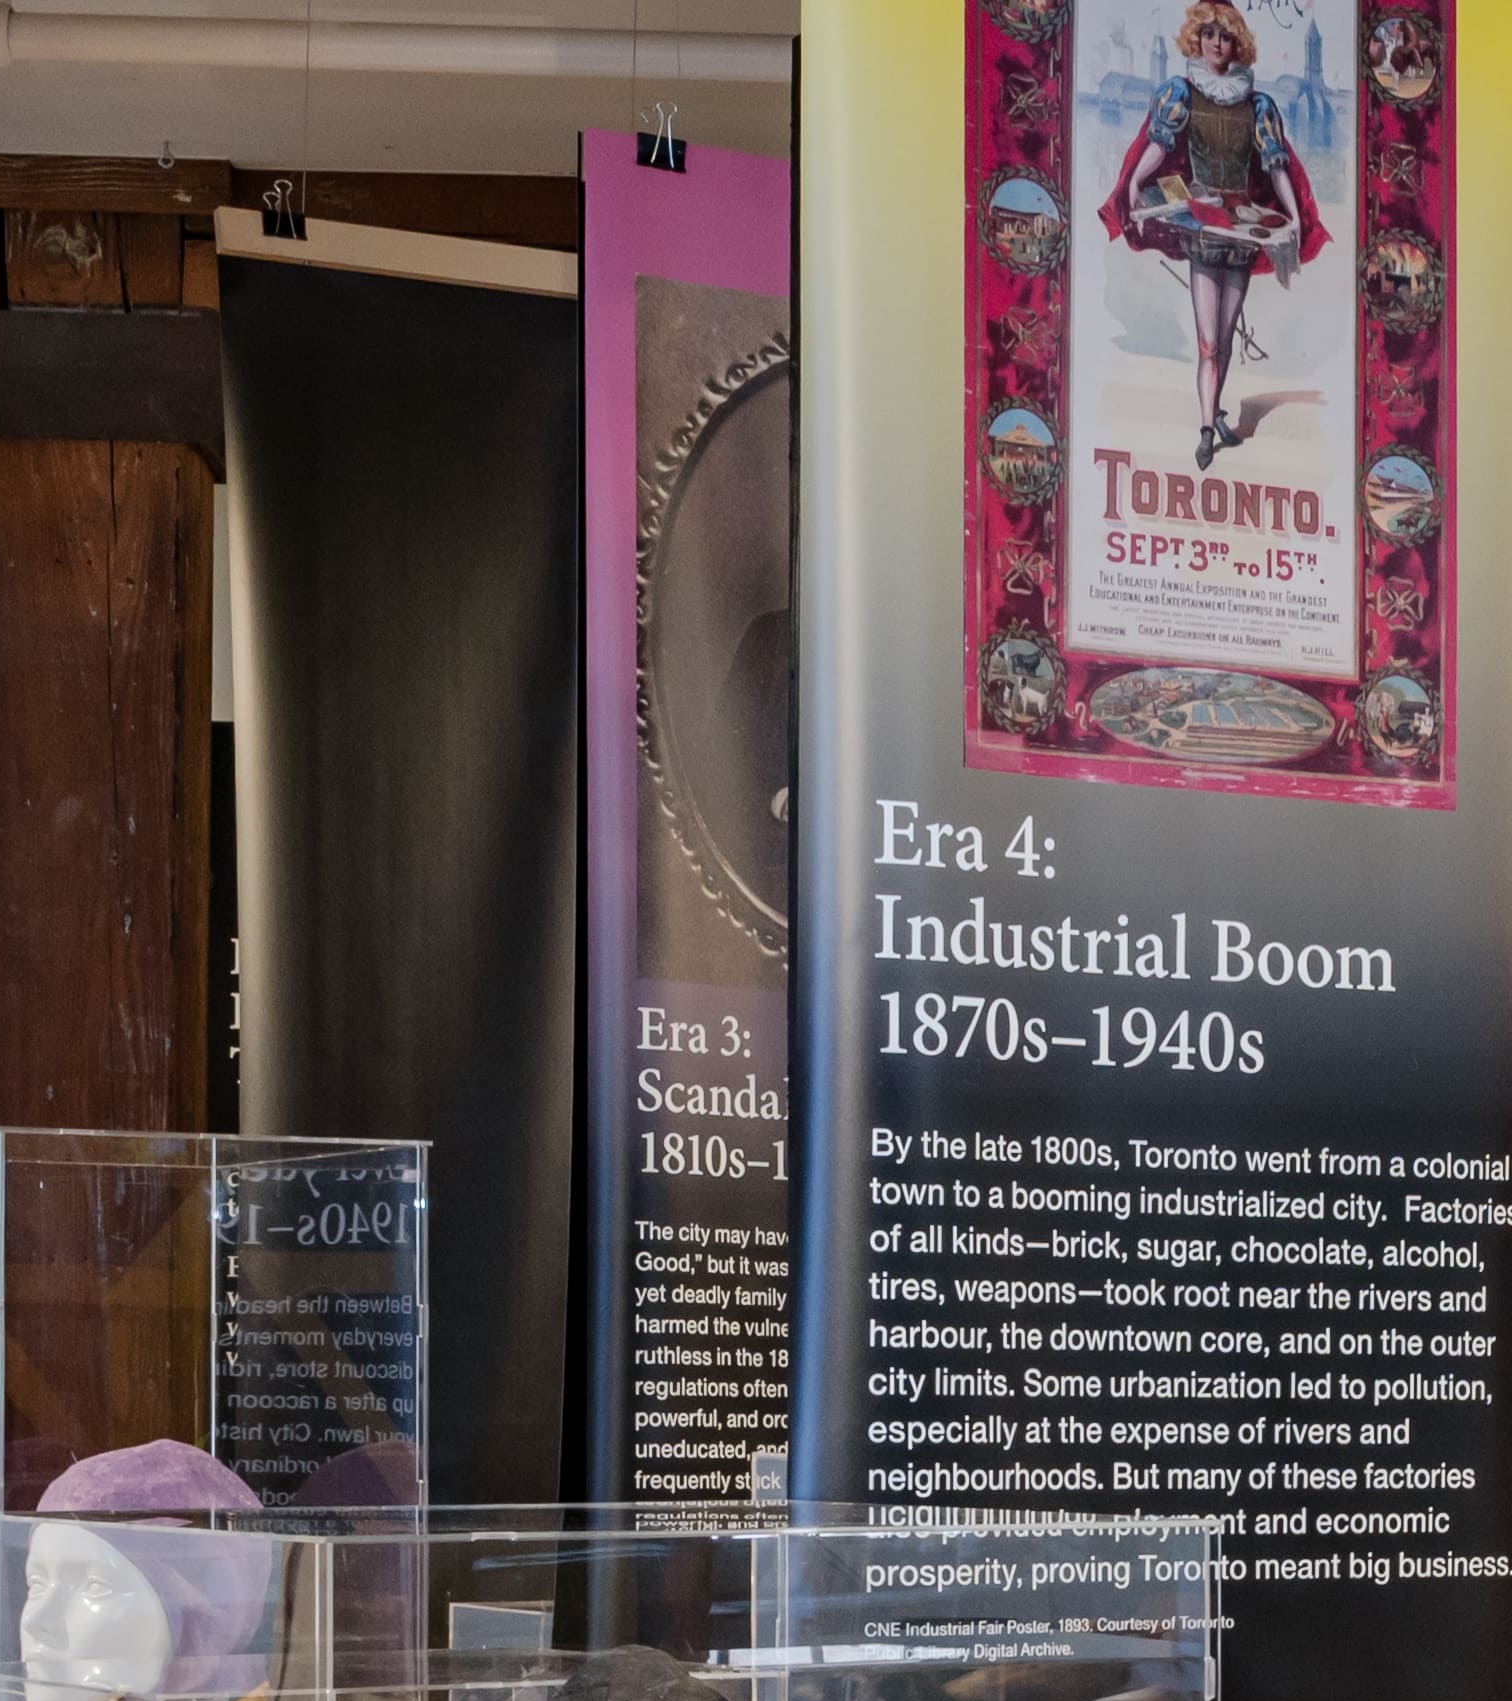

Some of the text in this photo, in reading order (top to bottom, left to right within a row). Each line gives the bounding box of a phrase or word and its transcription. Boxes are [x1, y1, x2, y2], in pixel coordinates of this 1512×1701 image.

[1094, 448, 1336, 537] TORONTO.
[874, 800, 1055, 879] Era 4:
[875, 894, 1395, 991] Industrial Boom
[637, 1007, 750, 1057] Era 3:
[880, 992, 1264, 1073] 1870s–1940s
[872, 1128, 1509, 1180] By the late 1800s, Toronto went from a colonial
[869, 1177, 944, 1205] town
[953, 1180, 980, 1207] to
[988, 1187, 1004, 1208] a
[1012, 1181, 1130, 1220] booming
[1140, 1186, 1324, 1219] industrialized
[1333, 1193, 1386, 1227] city.
[635, 1221, 788, 1249] The city may hav
[870, 1224, 901, 1252] of
[910, 1225, 942, 1253] all
[1137, 1238, 1221, 1267] sugar,
[1231, 1235, 1373, 1269] chocolate,
[1383, 1239, 1484, 1272] alcohol,
[635, 1284, 786, 1311] yet deadly family
[635, 1377, 788, 1400] regulations often
[869, 1462, 1475, 1497] neighbourhoods. But many of these factories
[864, 1618, 1092, 1637] CNE Industrial Fair Poster, 1893.
